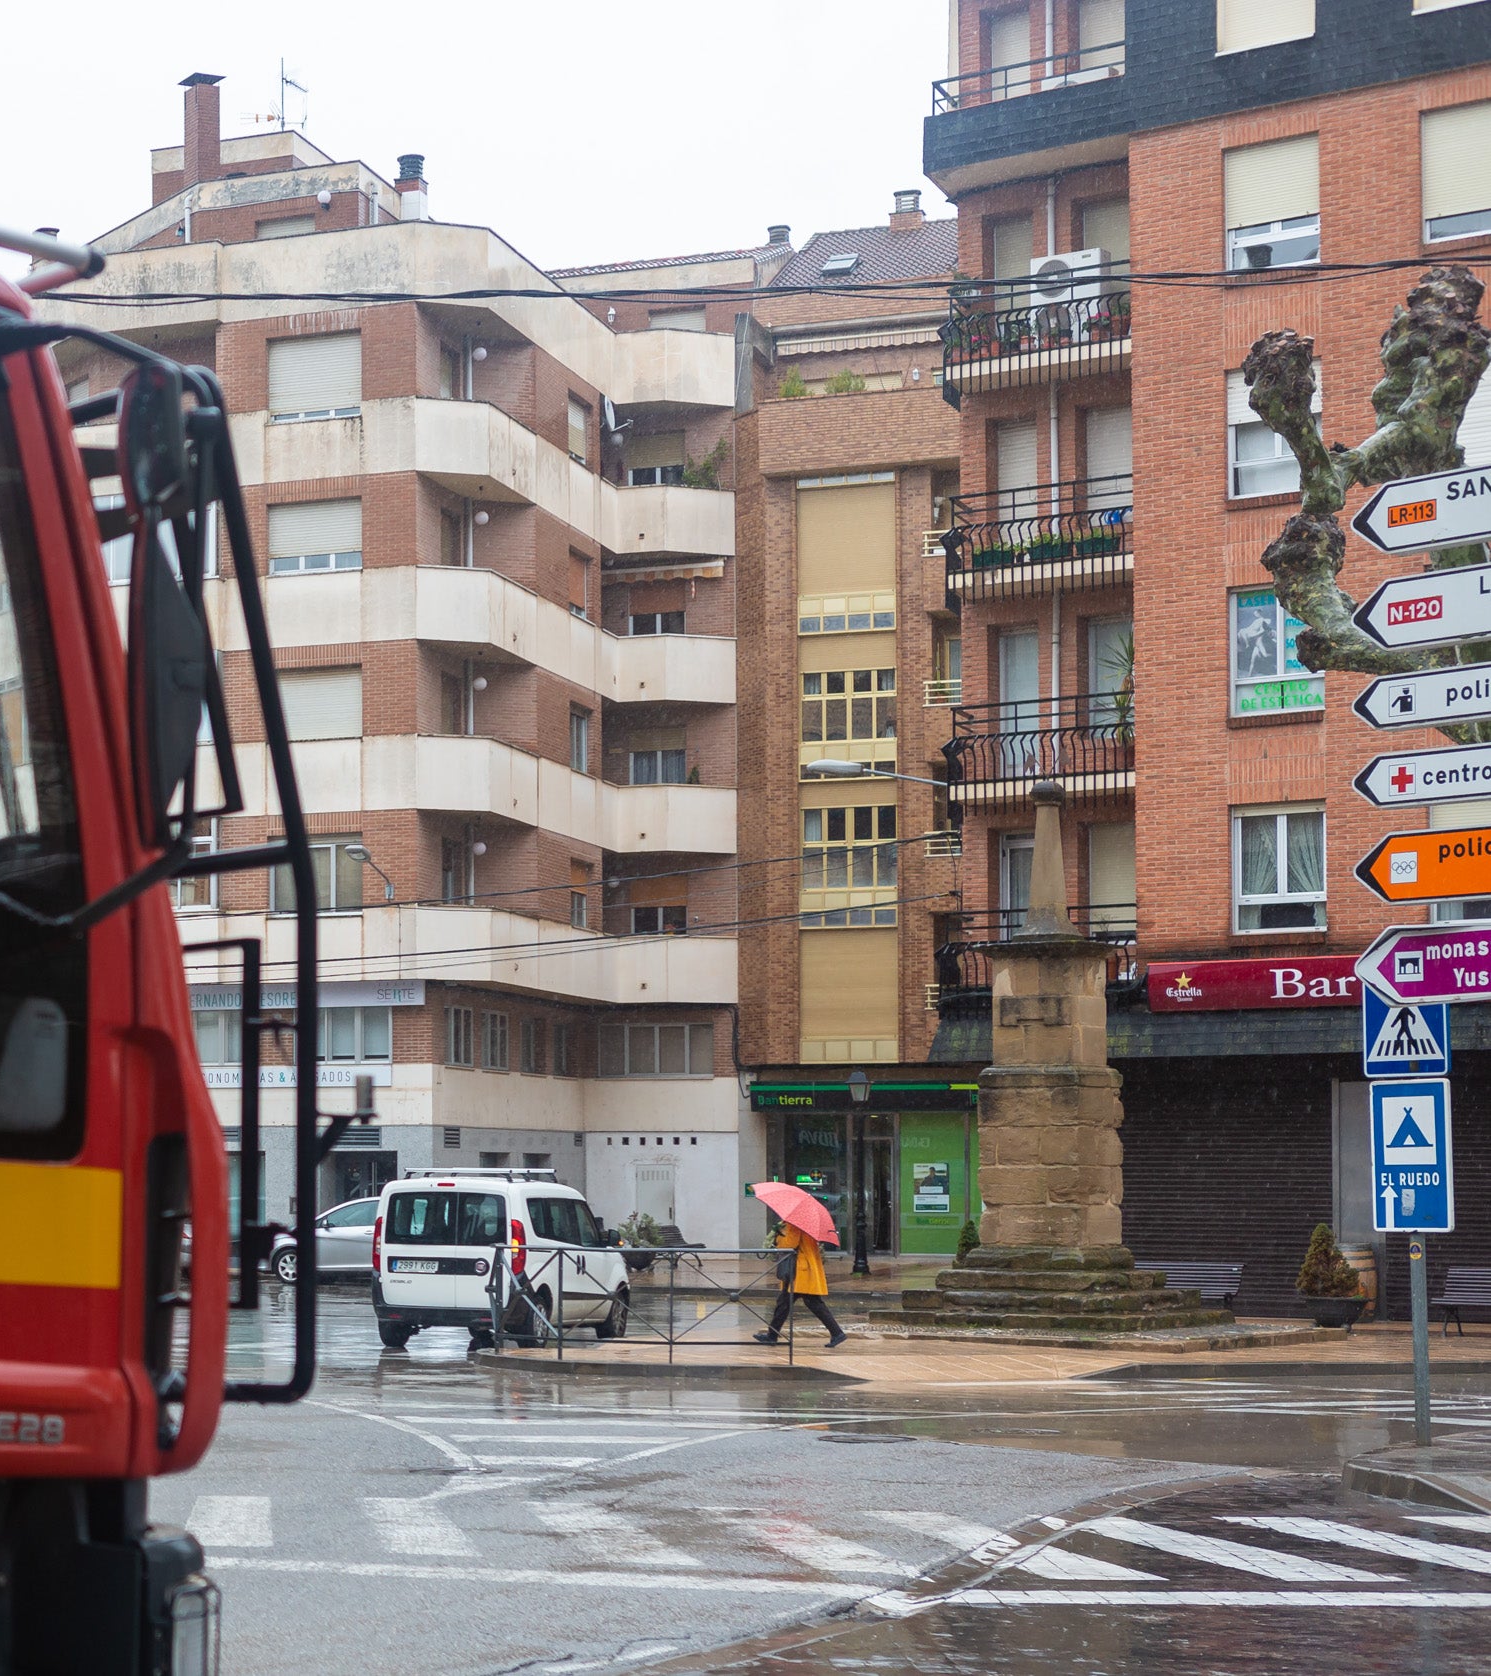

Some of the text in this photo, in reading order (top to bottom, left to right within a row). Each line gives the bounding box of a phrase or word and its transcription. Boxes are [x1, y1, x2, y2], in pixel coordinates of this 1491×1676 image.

[1390, 502, 1435, 525] LR-113
[1238, 594, 1275, 608] LASER
[1390, 599, 1441, 623] N-120
[1254, 680, 1309, 696] CENTRO
[1446, 678, 1490, 707] poli
[1241, 698, 1257, 711] DE
[1422, 763, 1491, 786] centro
[1426, 940, 1489, 960] monas
[1269, 968, 1357, 999] Bar
[1453, 967, 1489, 988] Yus
[189, 991, 297, 1008] ERNANDO ESORE
[1166, 986, 1203, 997] Estrella
[279, 1072, 286, 1083] &
[757, 1094, 813, 1106] Bantierra
[1380, 1172, 1440, 1187] EL RUEDO
